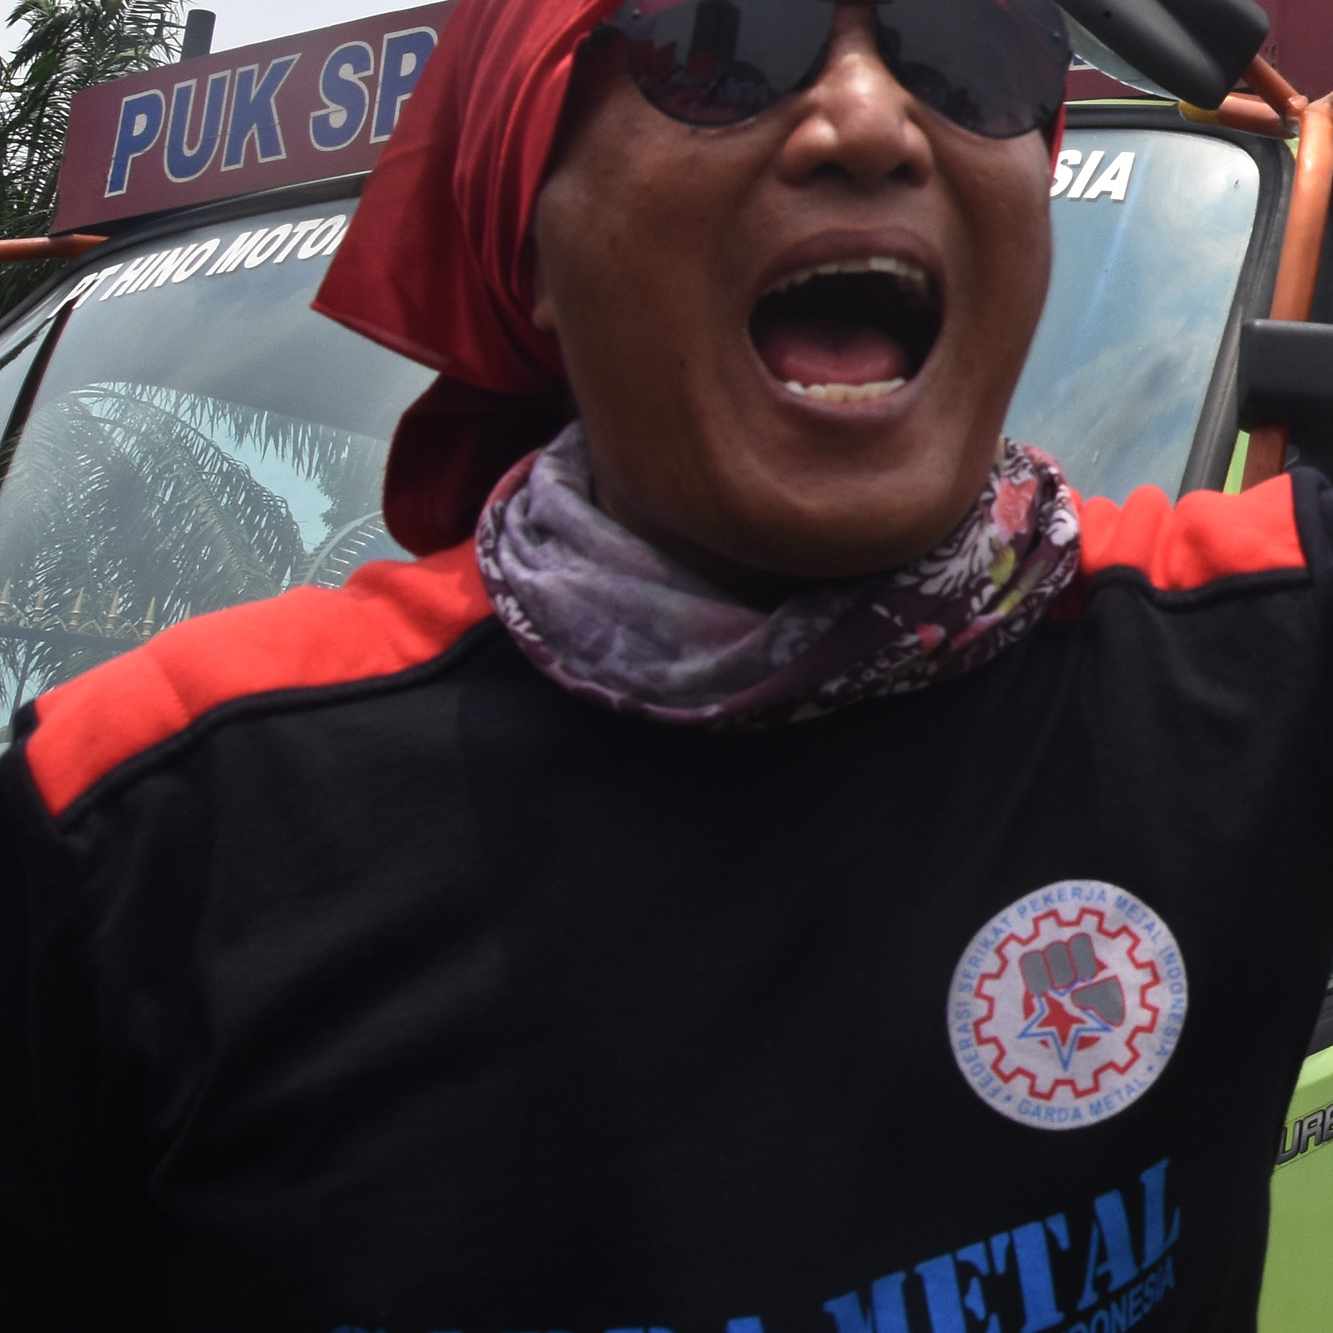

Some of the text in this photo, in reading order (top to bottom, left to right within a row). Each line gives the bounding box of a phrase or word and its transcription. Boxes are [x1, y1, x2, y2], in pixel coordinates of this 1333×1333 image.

[104, 53, 302, 198] PUK
[48, 263, 125, 319] PT
[100, 238, 220, 301] HINO
[955, 886, 1186, 1099] FEDERASI SERIKAT PEKERJA METAL INDONESIA
[1017, 1077, 1147, 1123] GARDA METAL
